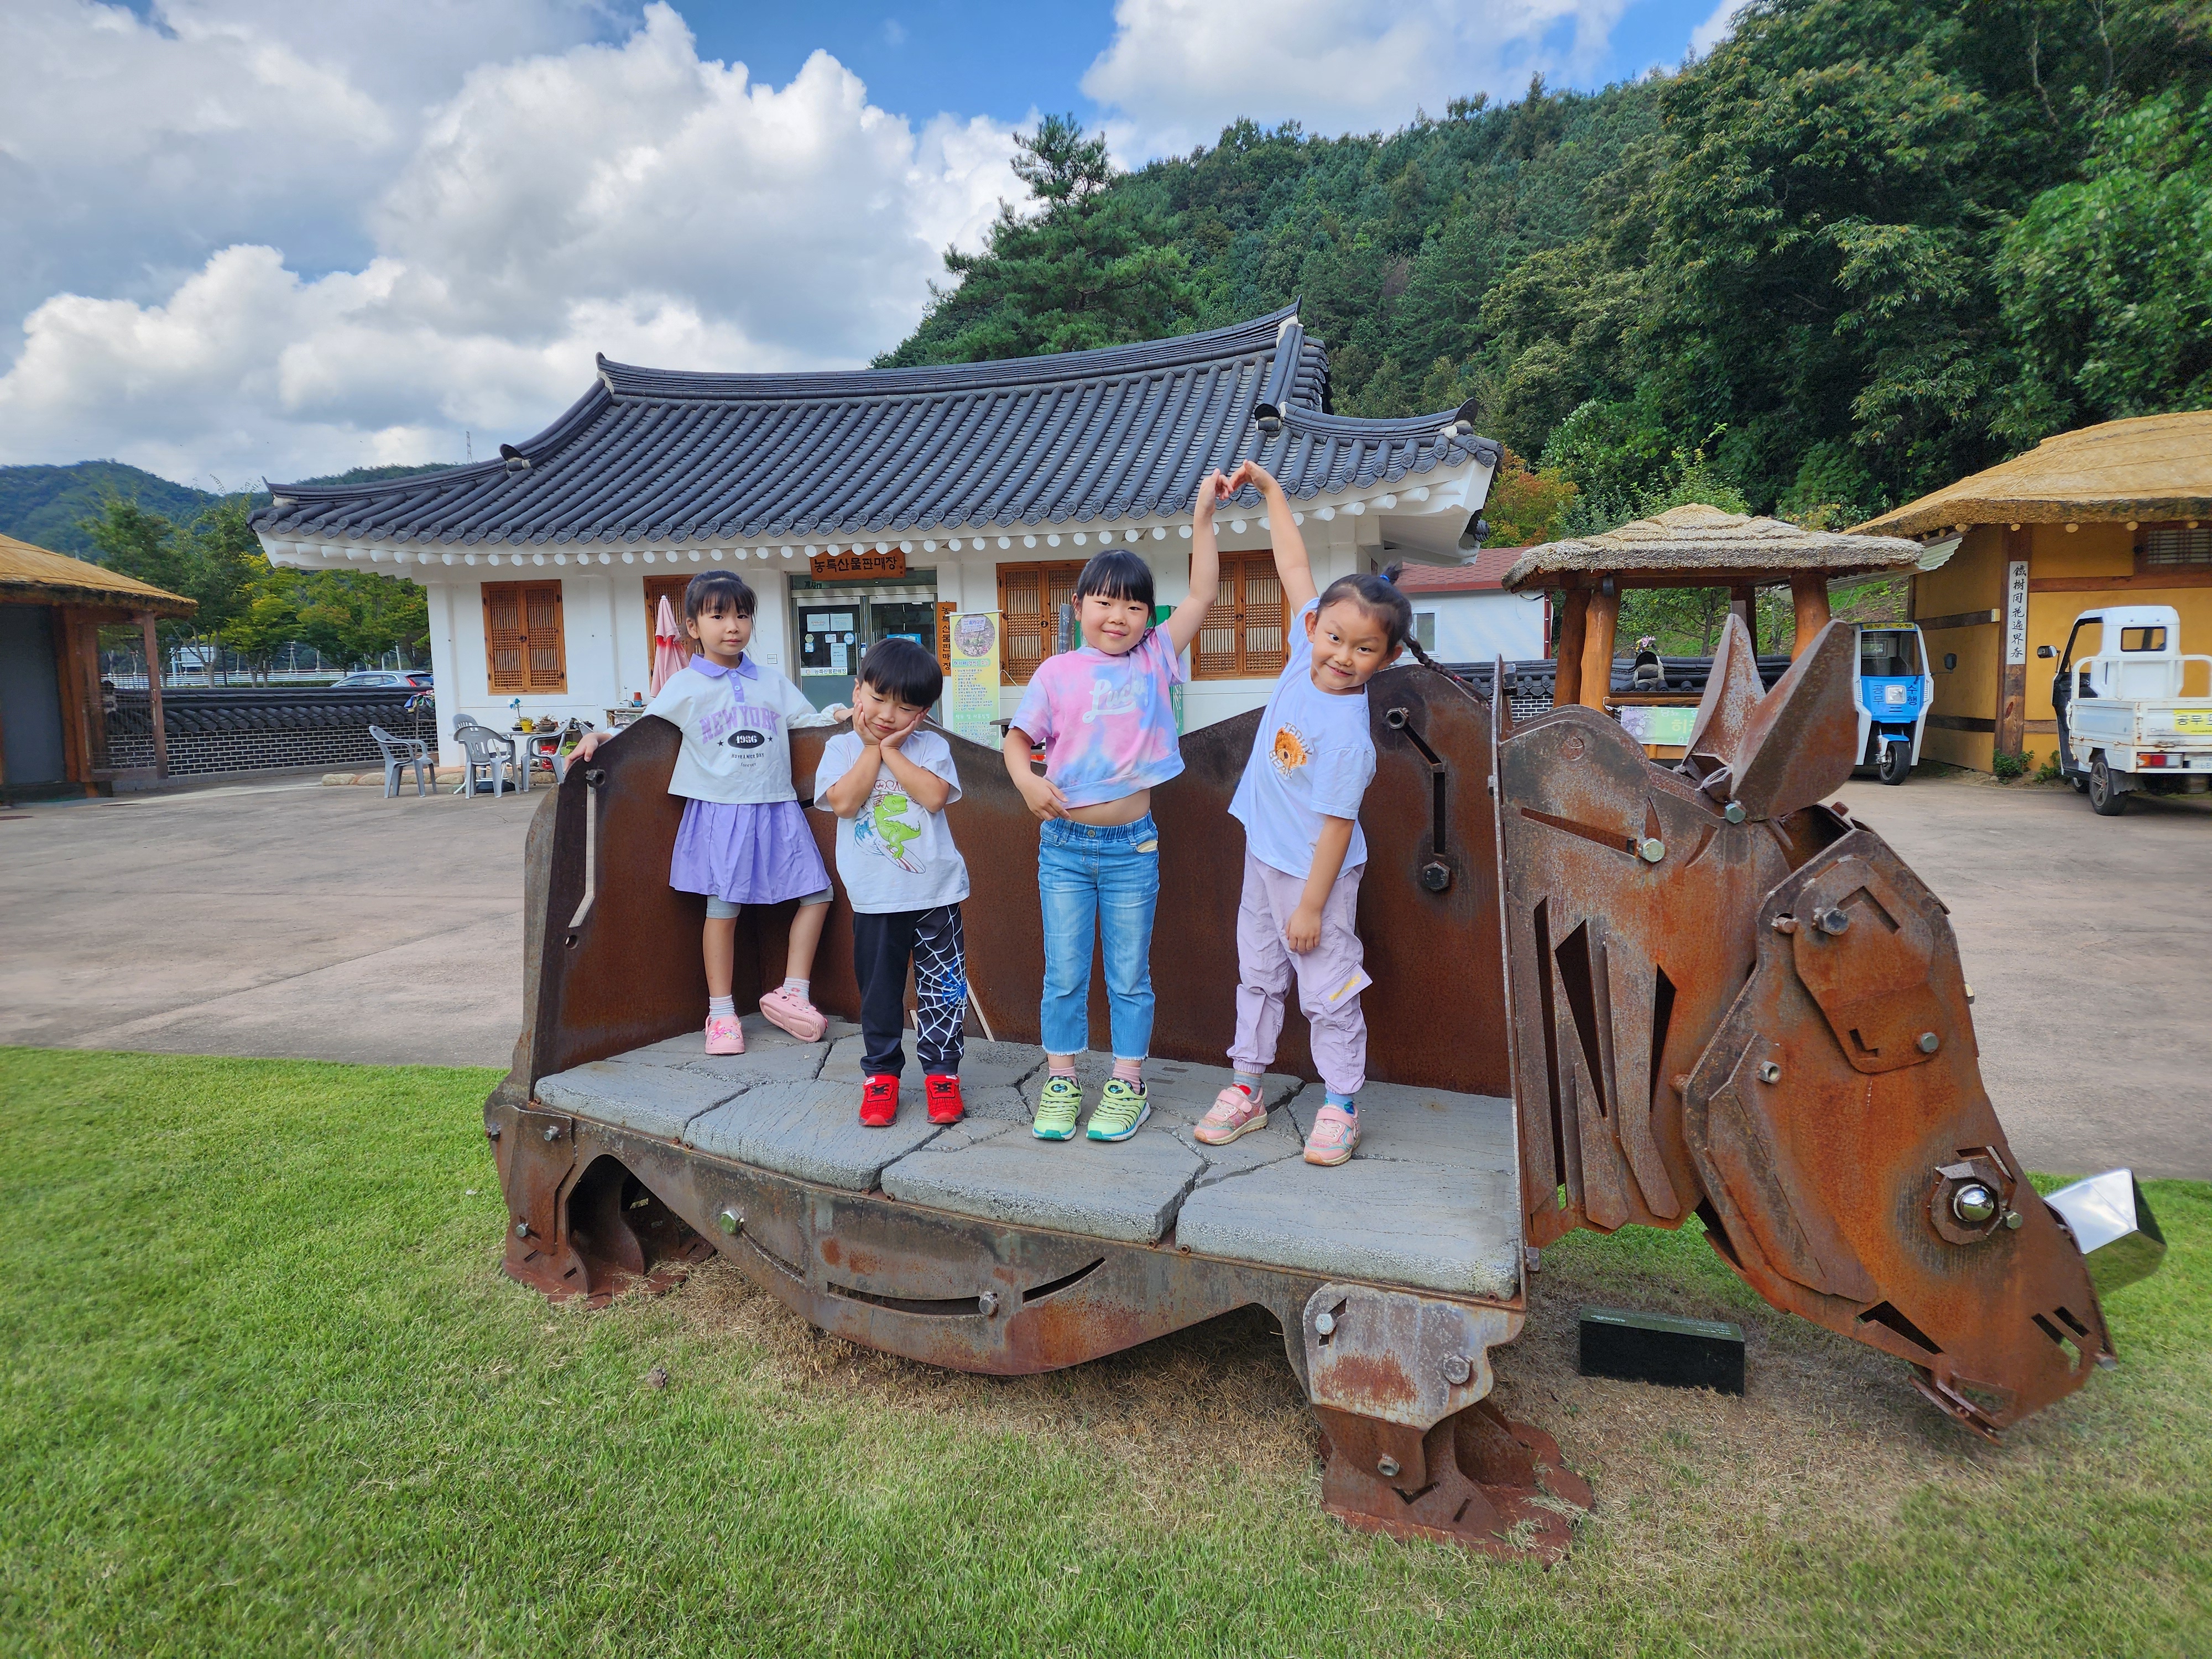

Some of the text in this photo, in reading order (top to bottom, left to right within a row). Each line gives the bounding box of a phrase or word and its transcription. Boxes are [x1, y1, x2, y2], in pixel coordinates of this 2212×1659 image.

[814, 556, 897, 573] 농특산물판매장
[1872, 685, 1884, 705] 공무
[1907, 685, 1917, 706] 수행
[699, 706, 781, 744] NEW YORK
[735, 735, 758, 744] 1986
[1269, 750, 1292, 779] BEAR
